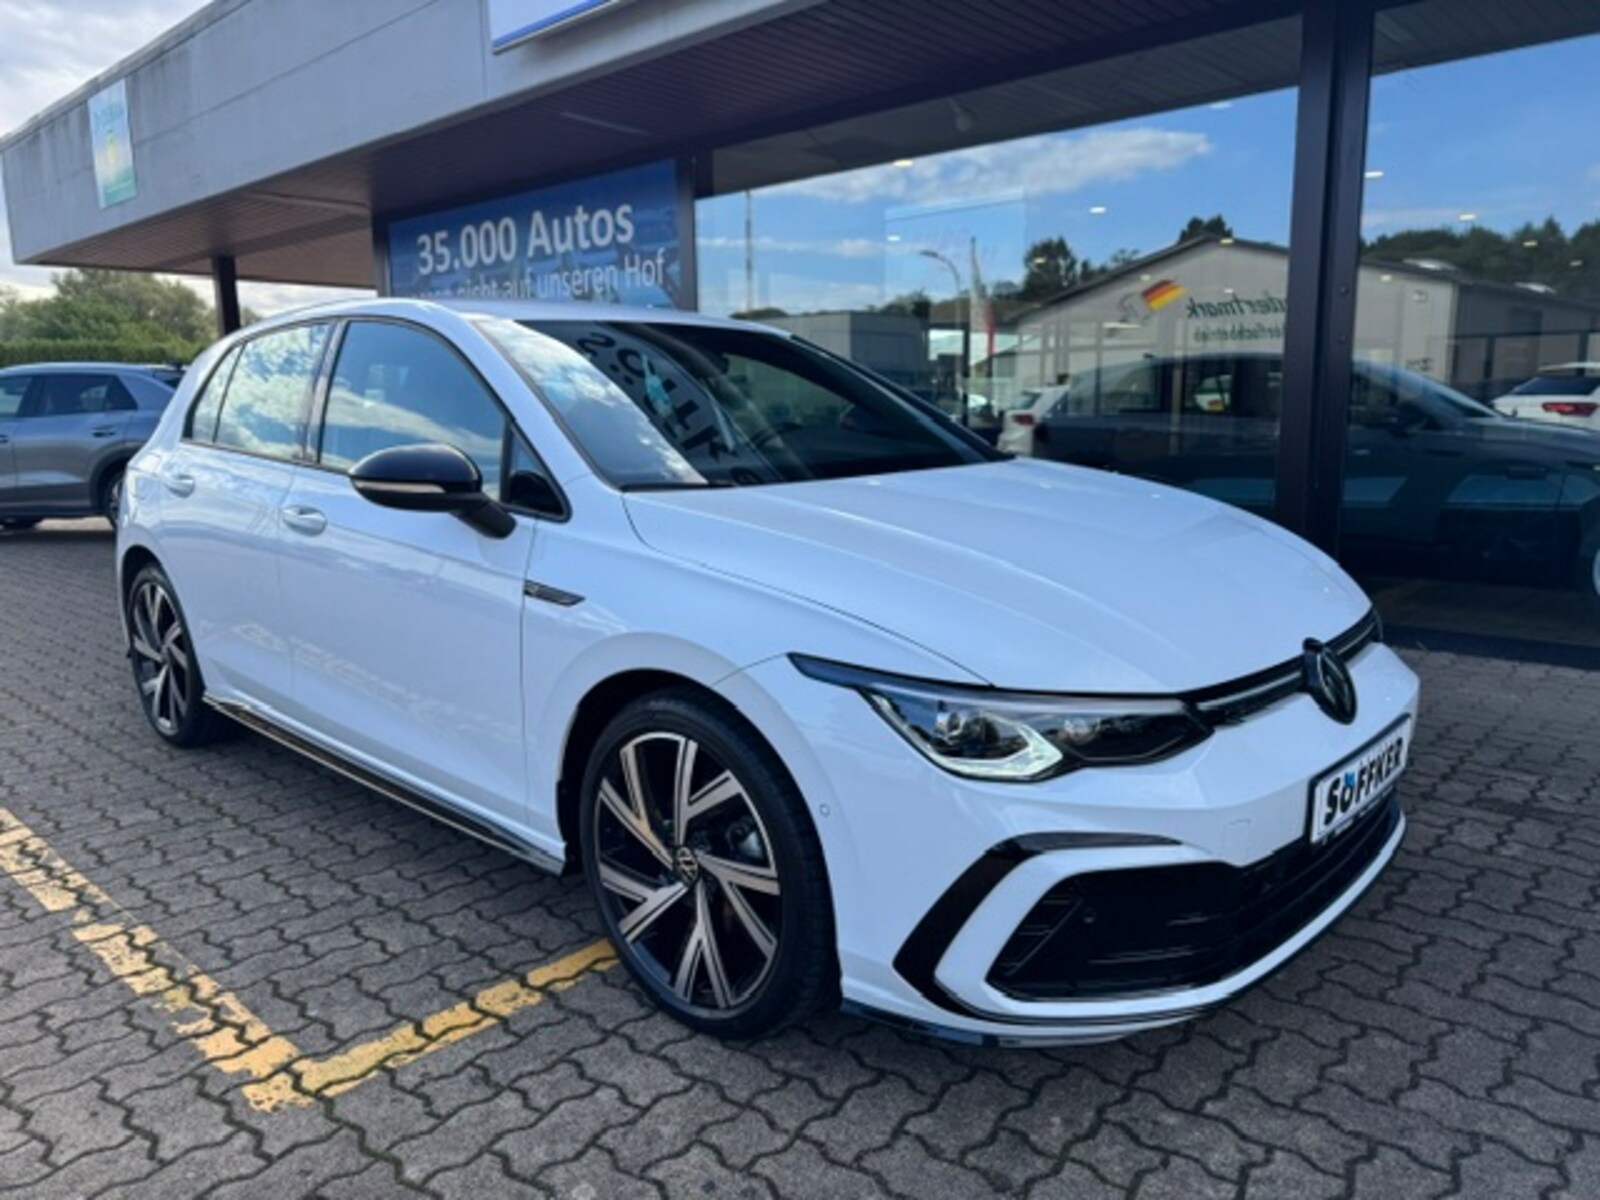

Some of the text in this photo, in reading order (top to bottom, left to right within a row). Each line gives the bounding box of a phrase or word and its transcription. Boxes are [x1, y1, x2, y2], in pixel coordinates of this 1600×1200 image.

[417, 204, 634, 275] 35.000 Autos
[503, 267, 533, 299] auf
[536, 263, 619, 298] unseren
[624, 247, 666, 287] Hof
